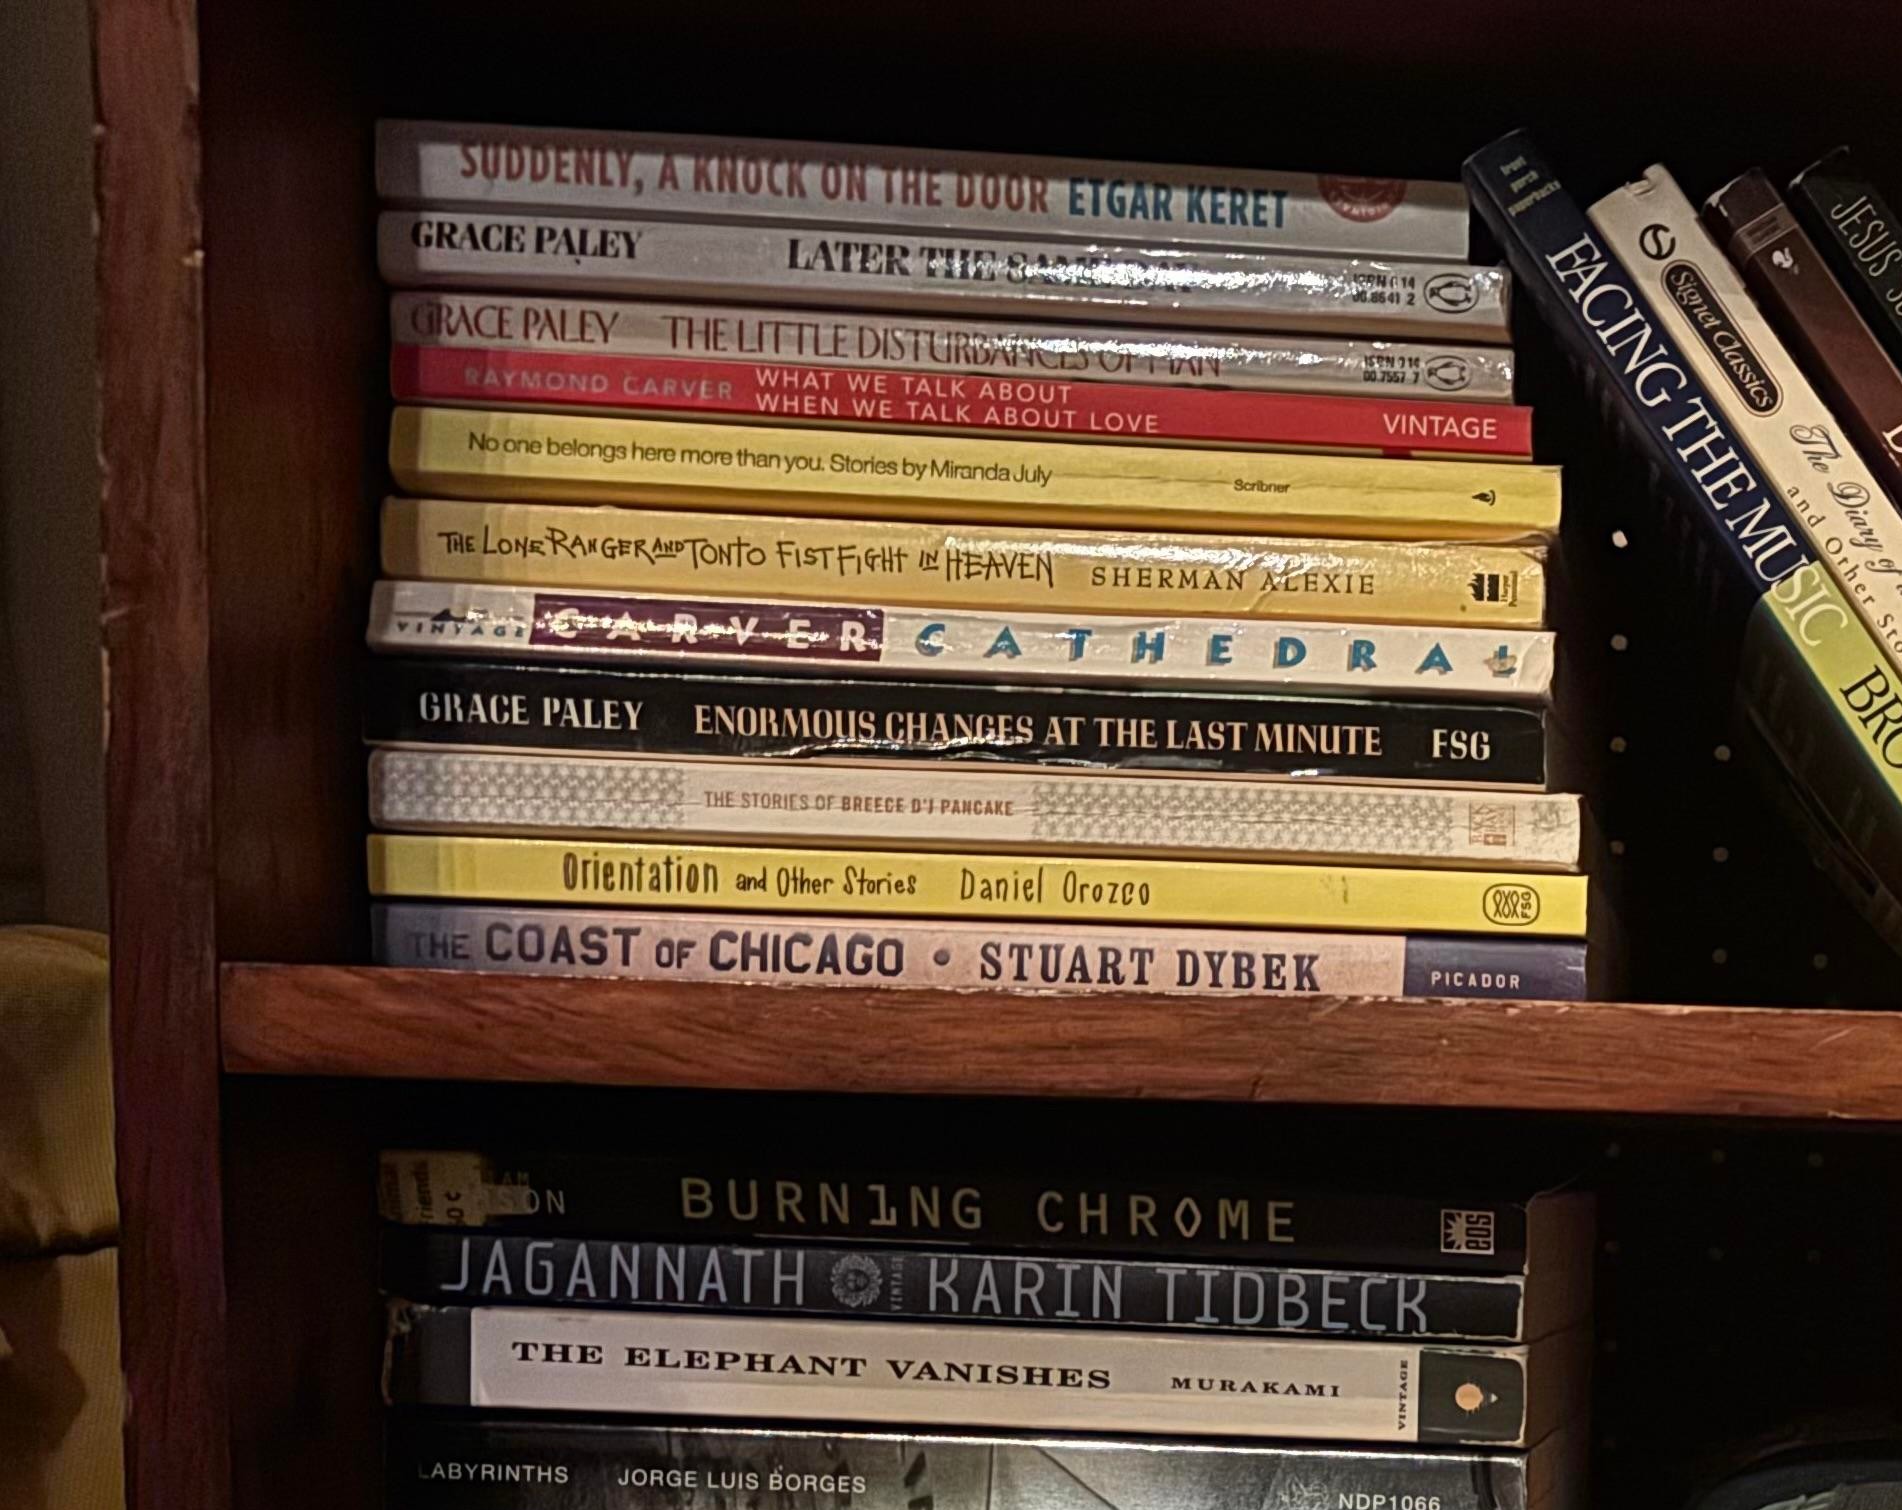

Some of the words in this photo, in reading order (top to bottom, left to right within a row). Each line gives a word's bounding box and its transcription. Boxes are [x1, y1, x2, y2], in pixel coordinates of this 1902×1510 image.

[461, 143, 645, 195] SUDDENLY,
[659, 154, 679, 191] A
[694, 157, 806, 199] KNOCK
[822, 161, 866, 201] ON
[883, 162, 942, 206] THE
[956, 174, 1048, 213] DOOR
[1069, 178, 1172, 221] ETGAR
[1187, 183, 1288, 227] KERET
[756, 367, 831, 391] WHAT
[848, 370, 887, 393] WE
[901, 373, 971, 398] TALK
[980, 383, 1072, 404] ABOUT
[756, 393, 838, 415] WHEN
[855, 398, 892, 419] WE
[907, 400, 971, 424] TALK
[984, 409, 1077, 430] ABOUT
[1090, 412, 1159, 433] LOVE
[1384, 414, 1497, 440] VINTAGE
[1234, 478, 1289, 495] Scribner
[563, 851, 719, 895] Orientation
[736, 869, 767, 893] and
[776, 870, 834, 897] Other
[843, 865, 917, 896] Stories
[960, 866, 1043, 904] Daniel
[1063, 872, 1151, 906] Orozco
[409, 933, 470, 961] THE
[485, 922, 641, 967] COAST
[655, 938, 696, 969] OF
[709, 931, 904, 977] CHICAGO
[980, 941, 1154, 987] STUART
[1177, 949, 1322, 992] DYBEK
[1431, 969, 1521, 990] PICADOR
[511, 1340, 604, 1366] THE
[624, 1346, 868, 1378] ELEPHANT
[885, 1359, 1112, 1390] VANISHES
[1170, 1376, 1341, 1398] MURAKAMI
[1396, 1358, 1409, 1431] VINTAGE
[417, 1462, 569, 1485] LABYRINTHS
[617, 1467, 698, 1489] JORGE
[706, 1470, 760, 1491] LUIS
[768, 1472, 867, 1494] BORGES
